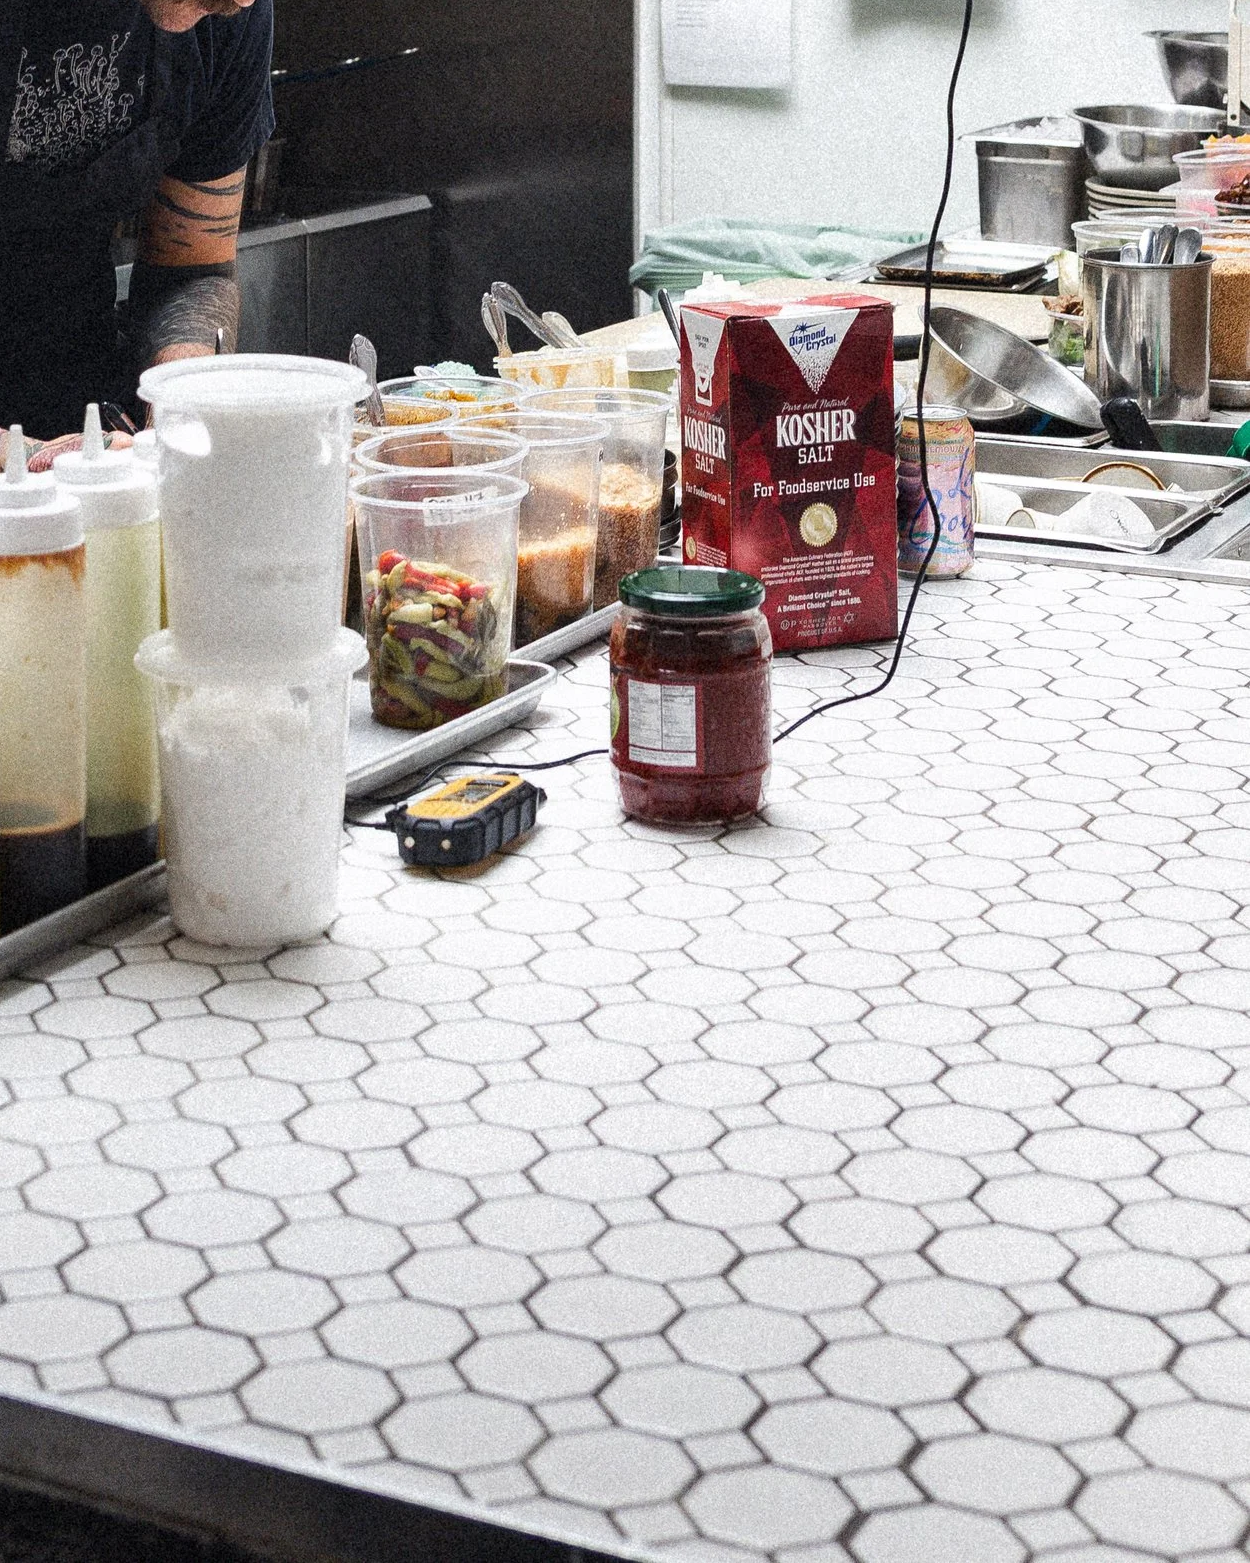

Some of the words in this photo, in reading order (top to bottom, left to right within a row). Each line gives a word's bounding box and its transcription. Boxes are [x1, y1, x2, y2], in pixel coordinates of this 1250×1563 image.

[789, 327, 826, 347] Diamond
[806, 334, 837, 351] Crystal
[782, 402, 800, 413] Pure
[803, 399, 817, 410] and
[819, 395, 850, 409] Natural
[776, 408, 857, 447] KOSHER
[684, 415, 727, 461] KOSHER
[695, 452, 715, 474] SALT
[798, 445, 834, 464] SALT
[685, 481, 693, 493] For
[693, 484, 717, 502] Foodservice
[717, 494, 726, 506] Use
[753, 482, 774, 497] For
[778, 477, 850, 496] Foodservice
[853, 472, 876, 488] Use
[789, 593, 813, 602] Diamond
[783, 604, 805, 612] Brilliant
